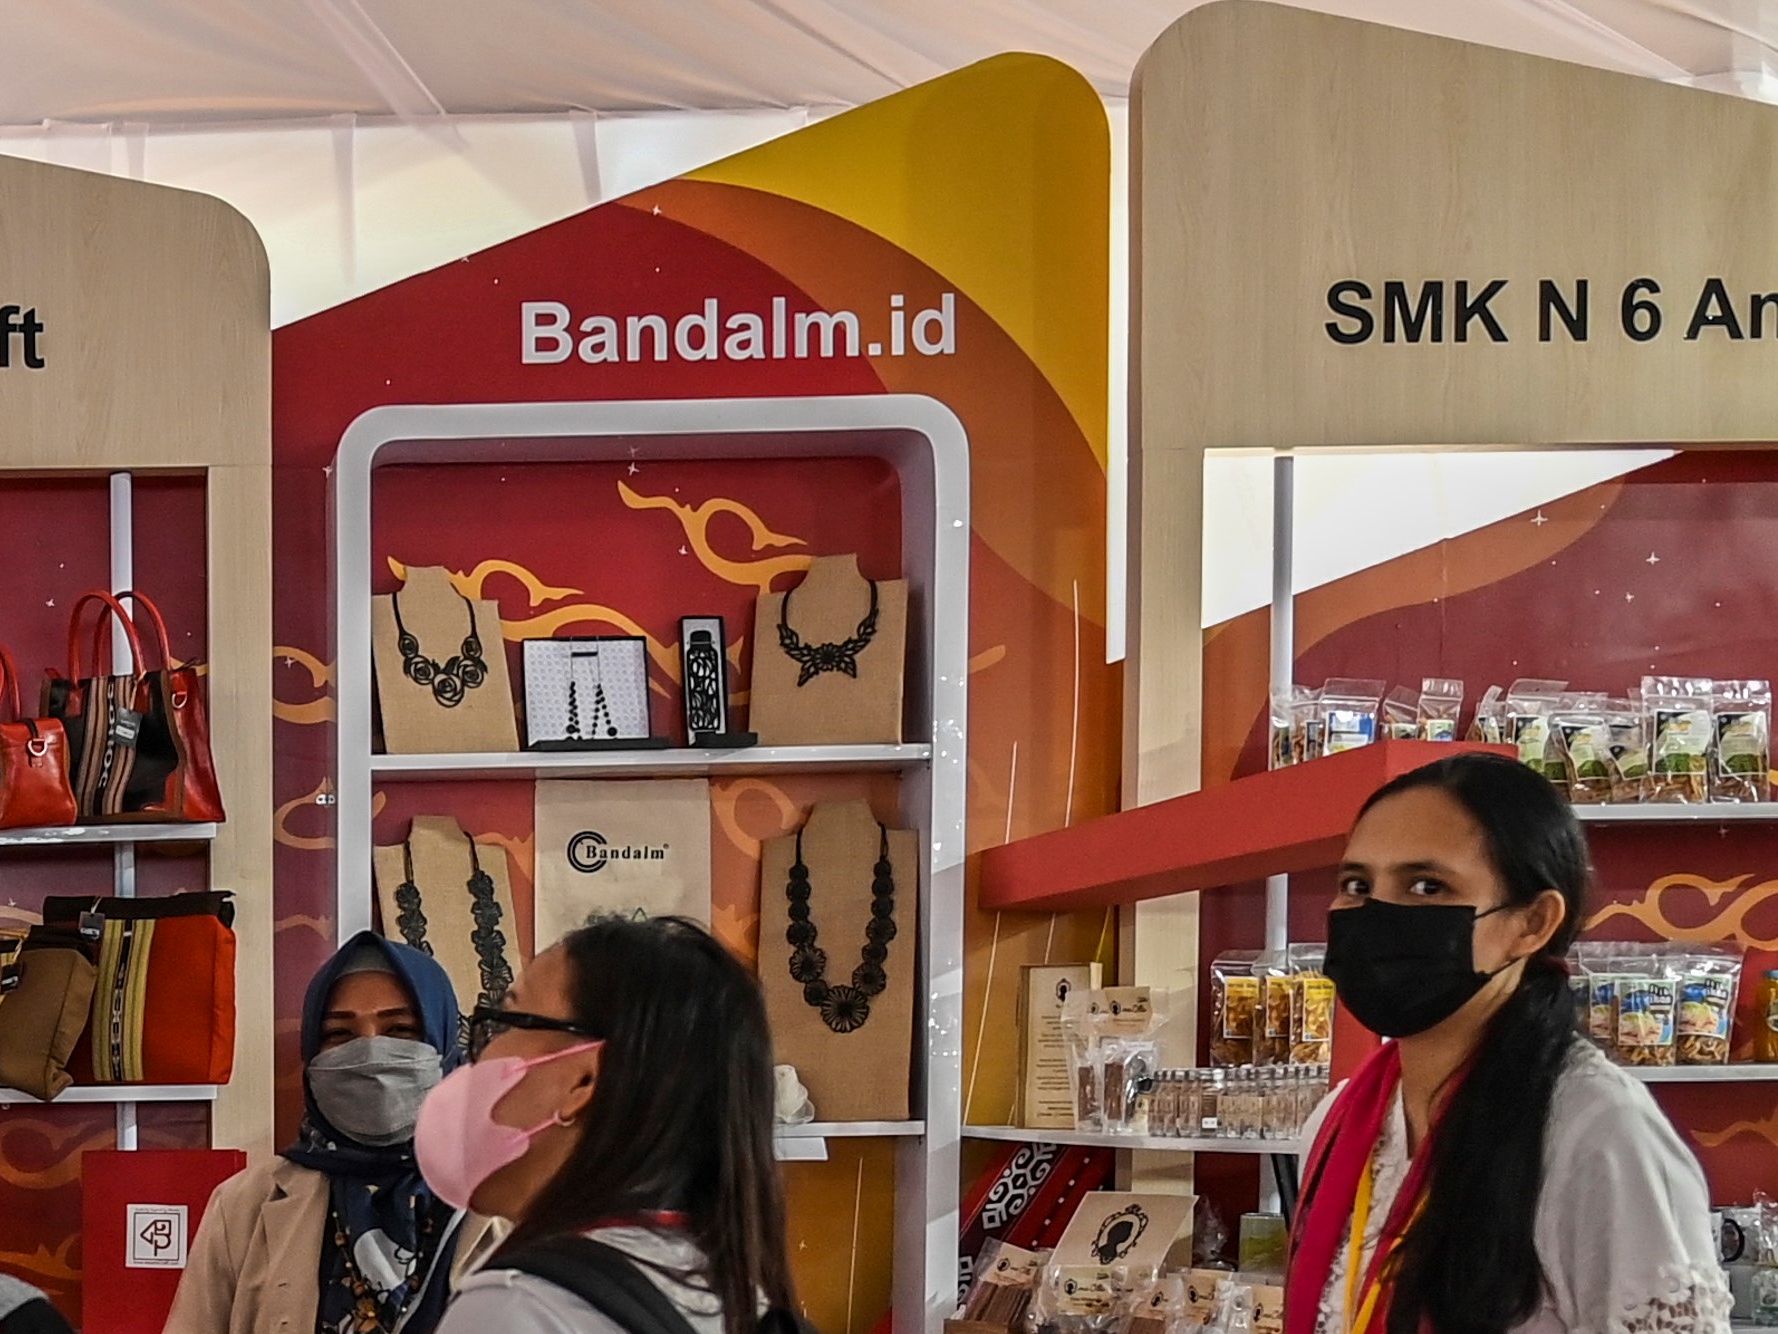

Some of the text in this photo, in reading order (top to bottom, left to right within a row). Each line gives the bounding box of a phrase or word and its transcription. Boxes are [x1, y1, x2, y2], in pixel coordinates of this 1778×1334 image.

[520, 292, 957, 365] Bandalm.id
[1324, 279, 1510, 345] SMK
[1538, 278, 1590, 342] N
[1620, 277, 1663, 342] 6
[585, 844, 665, 860] Bandalm
